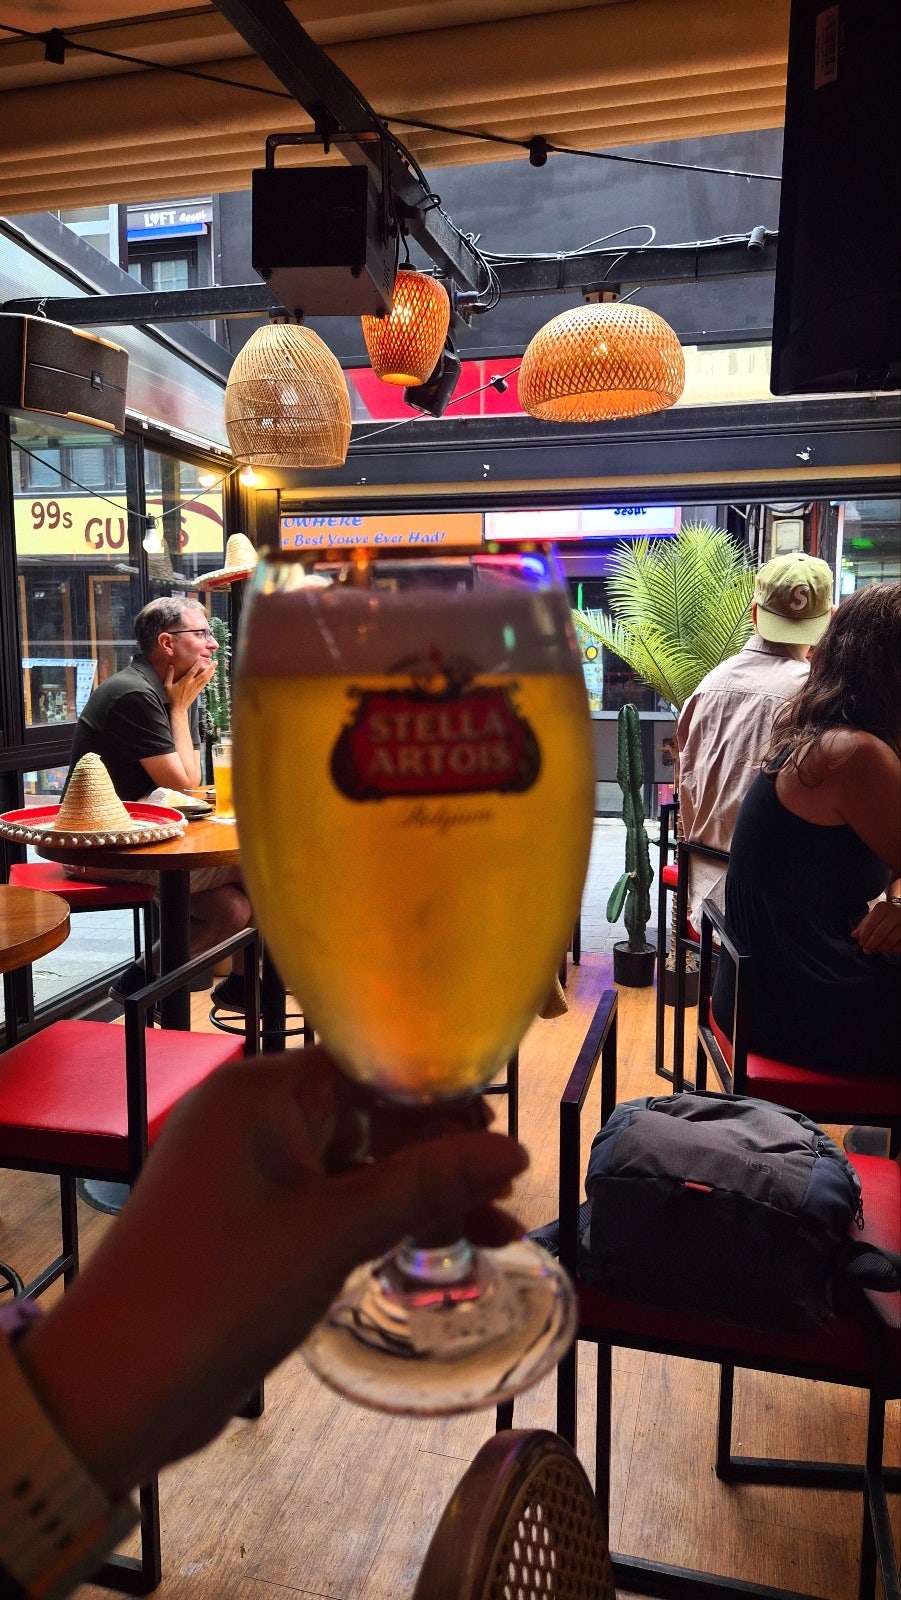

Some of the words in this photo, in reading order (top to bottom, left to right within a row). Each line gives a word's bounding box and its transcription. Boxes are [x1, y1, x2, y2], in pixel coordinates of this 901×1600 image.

[31, 501, 72, 529] 99s
[294, 533, 324, 547] Best
[408, 530, 445, 544] Had!
[790, 585, 809, 610] S
[368, 710, 506, 742] STELLA
[368, 742, 512, 776] ARTOIS
